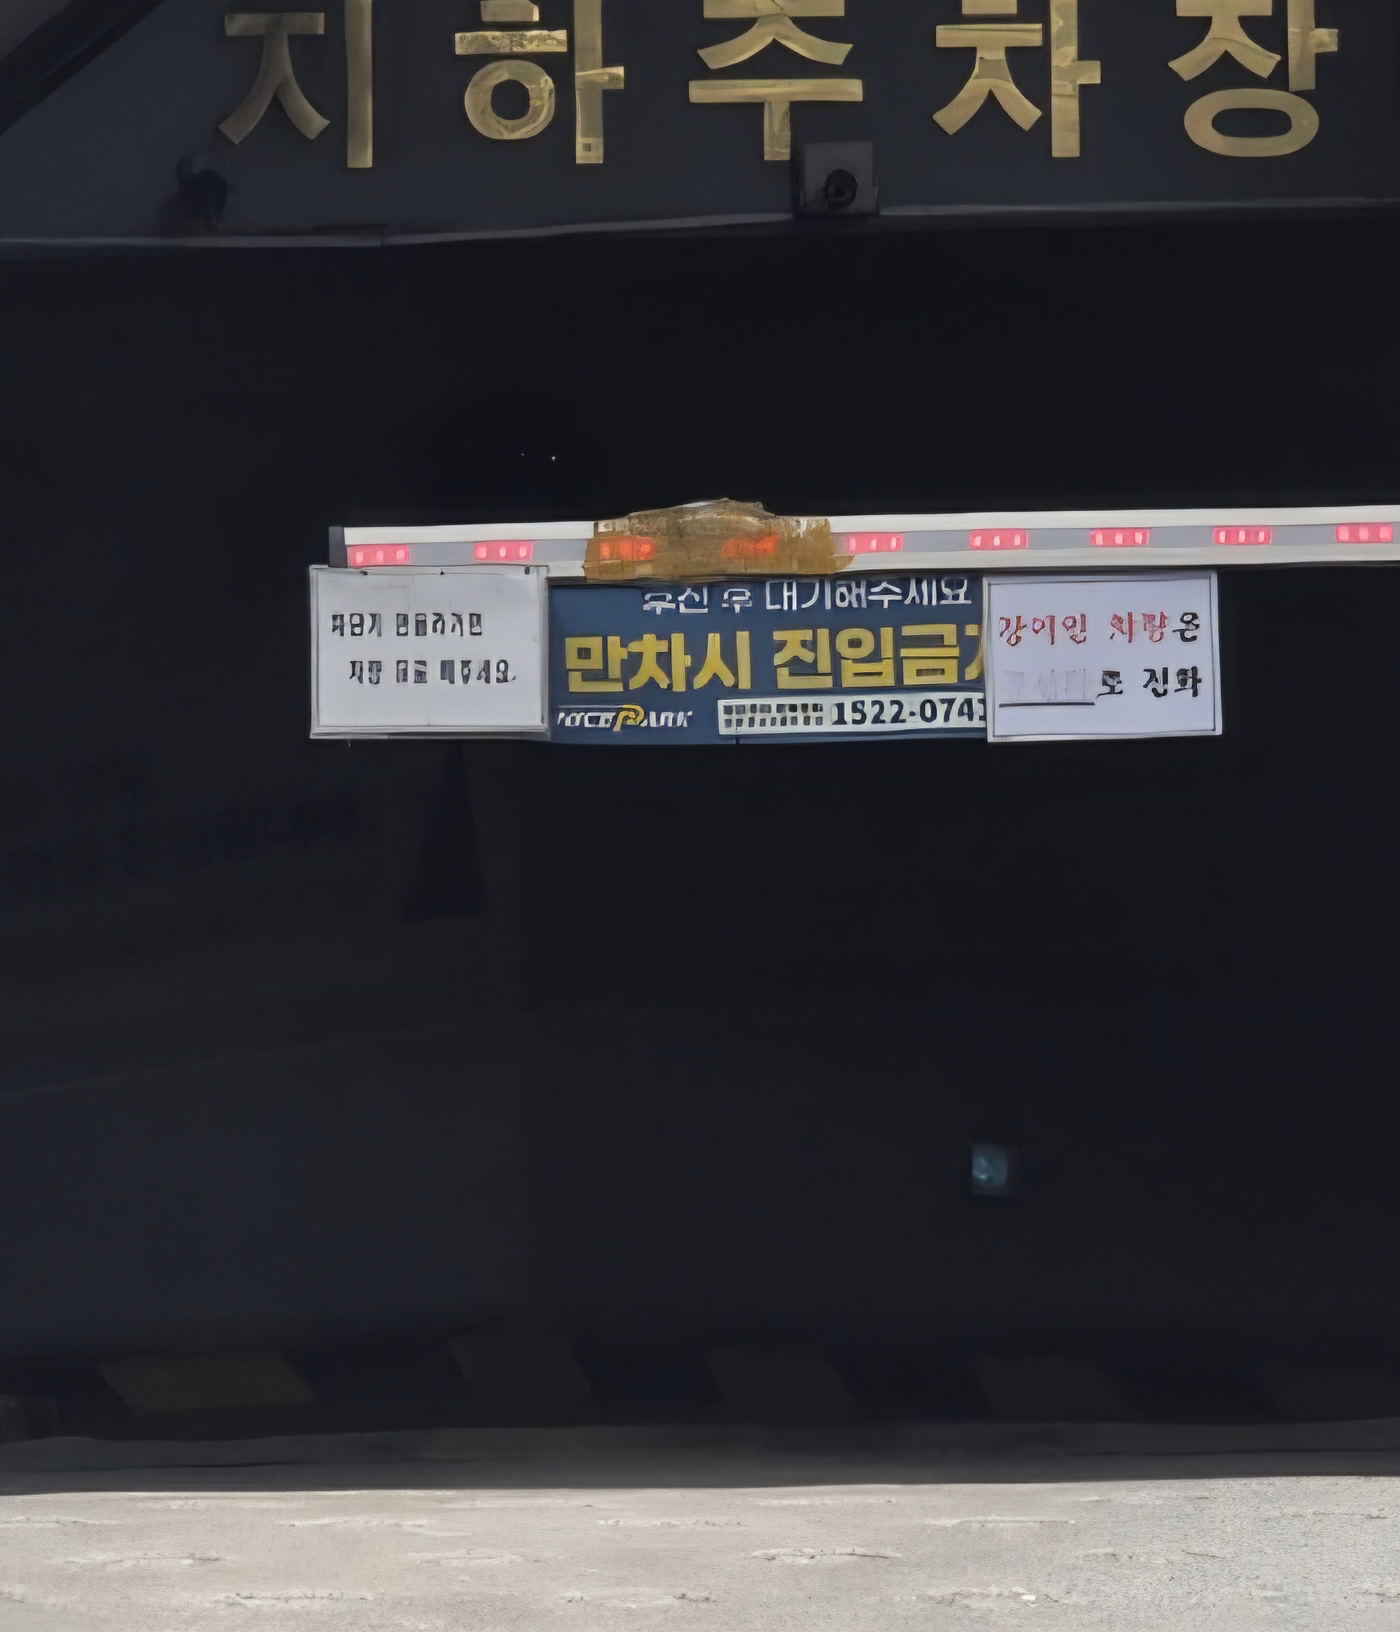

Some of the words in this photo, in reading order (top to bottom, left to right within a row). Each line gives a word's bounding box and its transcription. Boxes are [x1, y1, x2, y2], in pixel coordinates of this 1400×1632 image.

[766, 580, 971, 610] 대기해주세요
[567, 632, 750, 691] 만차시
[775, 624, 981, 687] 진입금
